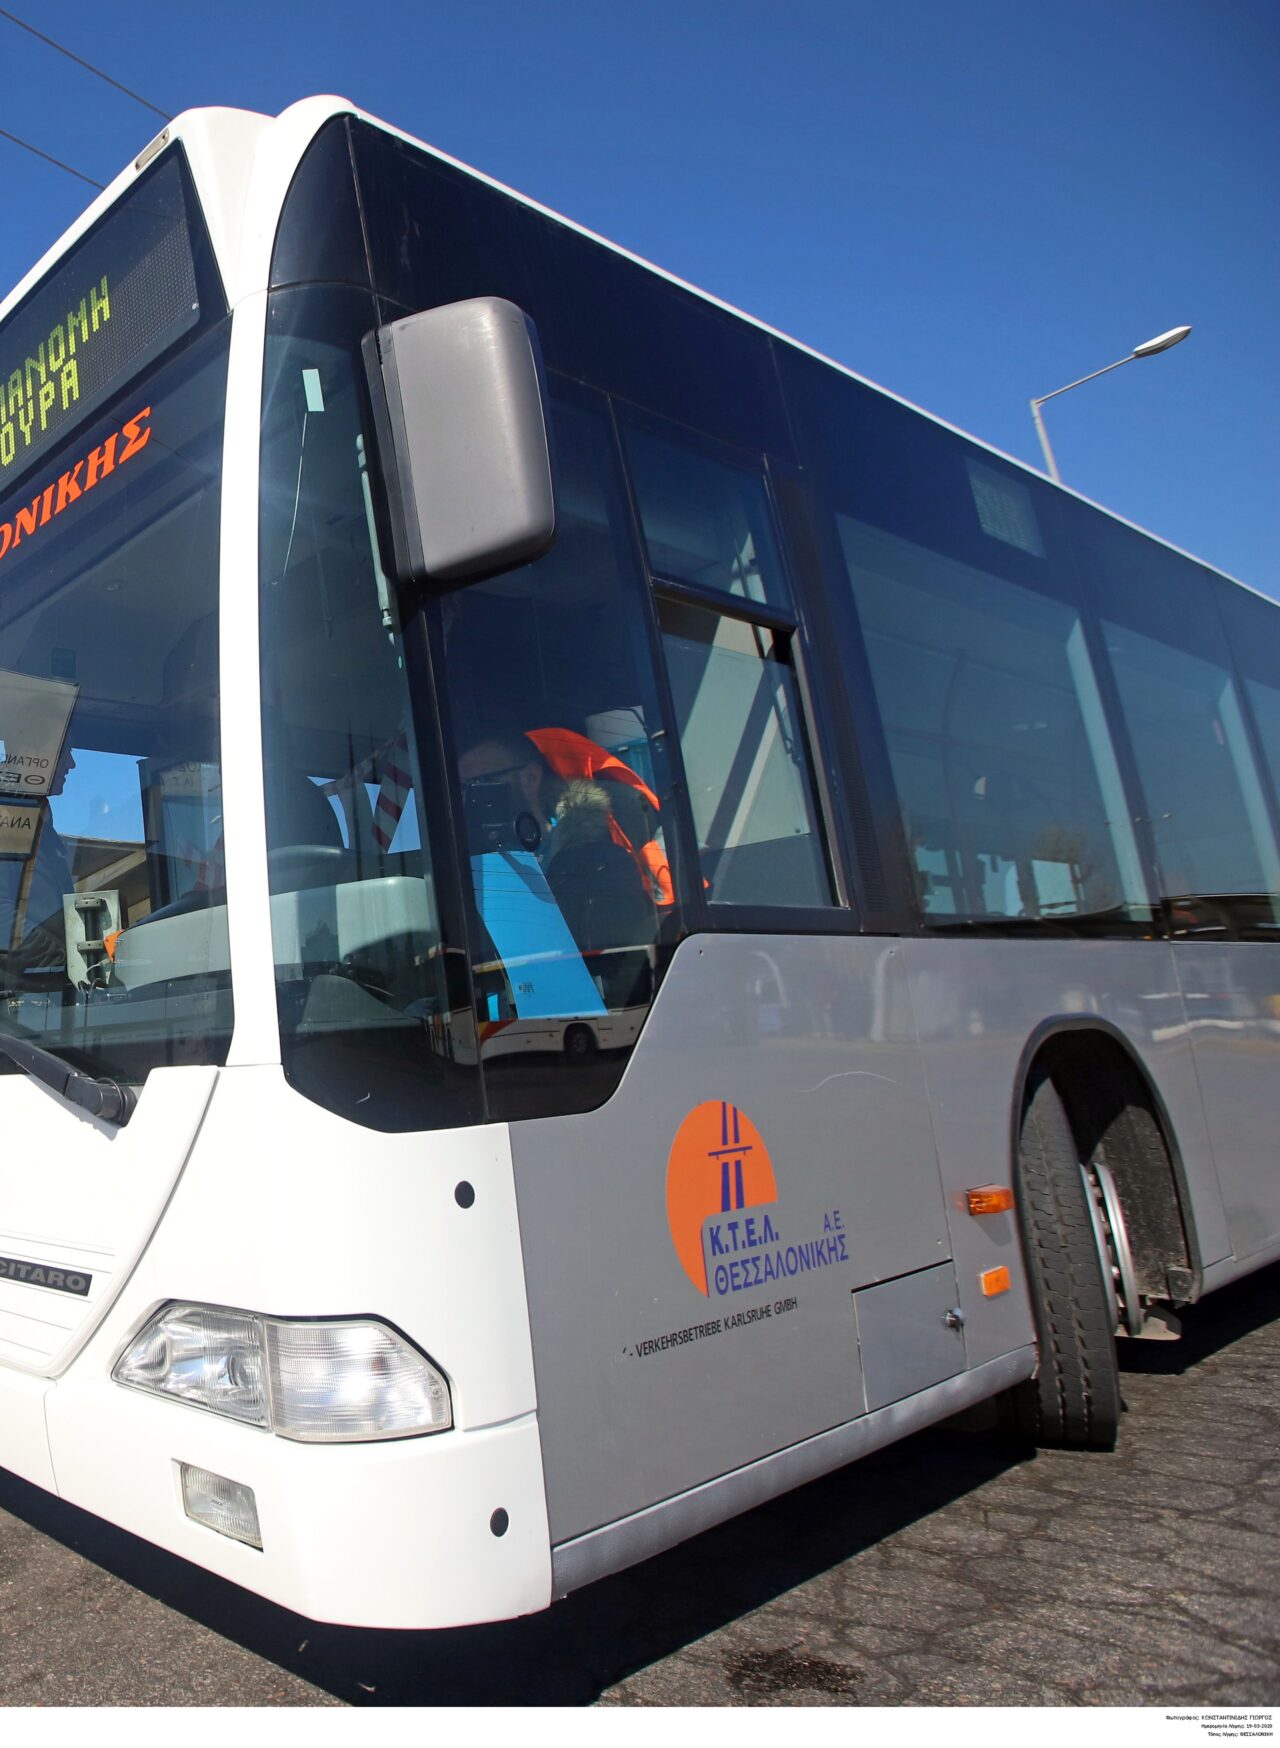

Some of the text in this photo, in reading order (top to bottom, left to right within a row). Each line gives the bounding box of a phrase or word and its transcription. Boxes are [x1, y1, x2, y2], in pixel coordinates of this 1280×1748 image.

[709, 1214, 780, 1257] Κ.Τ.Ε.Λ.
[714, 1233, 849, 1296] ΘΕΣΣΑΛΟΝΙΚΗΣ
[635, 1319, 722, 1358] VERKEHRSBETRIEBE
[723, 1304, 773, 1331] KARLSRUHE
[773, 1297, 798, 1316] GMBH
